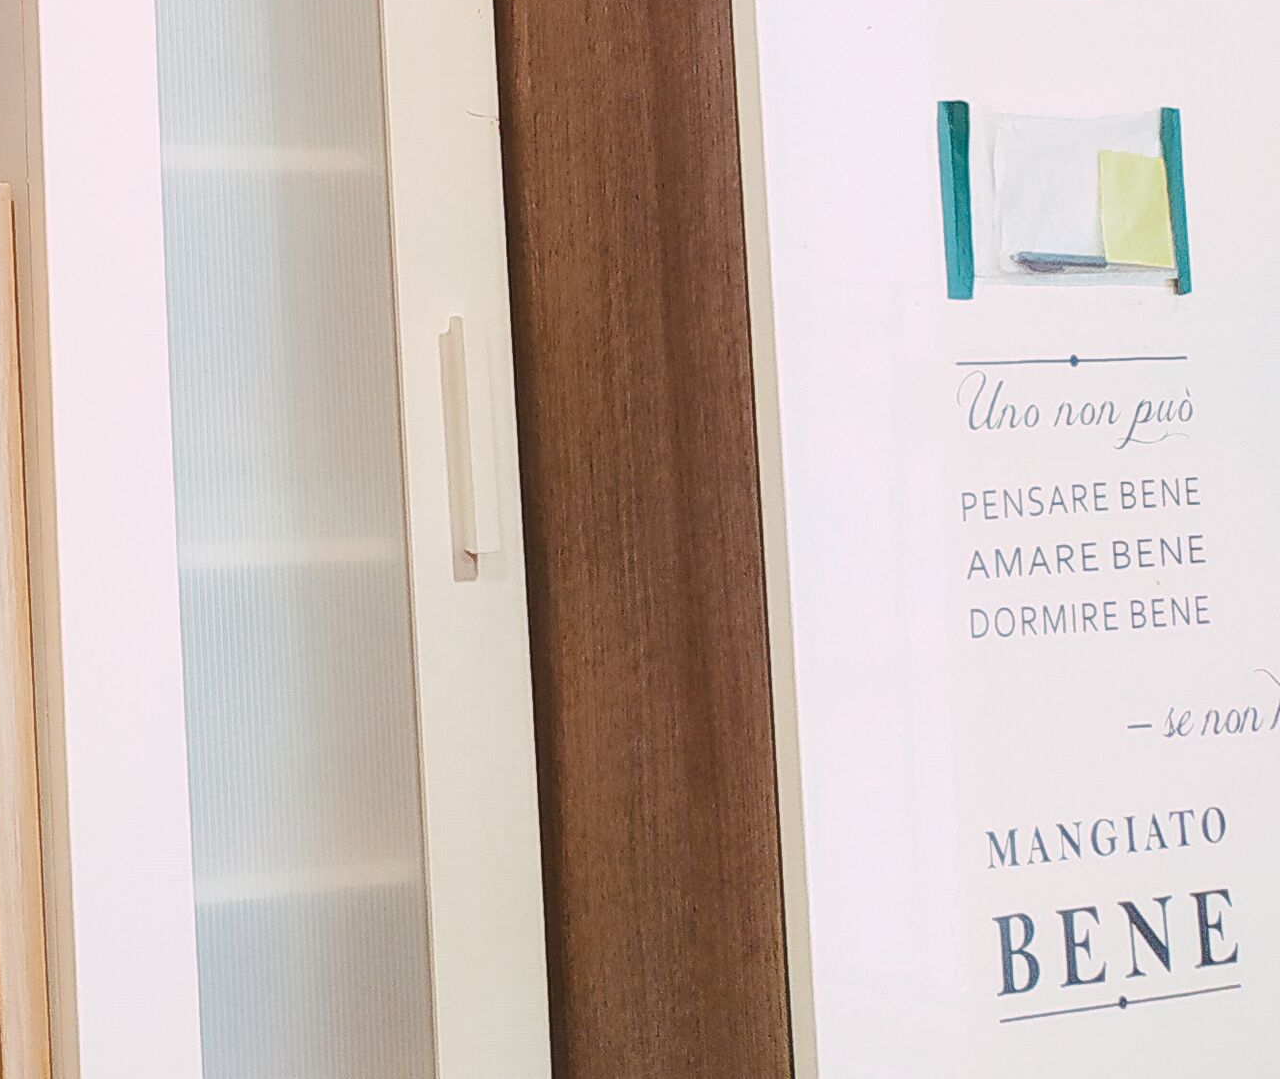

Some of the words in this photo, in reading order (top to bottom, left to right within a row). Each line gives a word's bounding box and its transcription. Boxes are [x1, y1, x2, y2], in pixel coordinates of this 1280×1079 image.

[956, 370, 1040, 430] Uno
[1053, 399, 1121, 427] non
[1113, 385, 1194, 450] può
[961, 482, 1109, 522] PENSARE
[1120, 477, 1201, 510] BENE
[966, 541, 1100, 581] AMARE
[1112, 534, 1207, 570] BENE
[969, 600, 1119, 639] DORMIRE
[1129, 594, 1211, 629] BENE
[1162, 706, 1193, 738] se
[1200, 706, 1263, 736] non
[985, 806, 1226, 869] MANGIATO
[992, 888, 1239, 997] BENE
